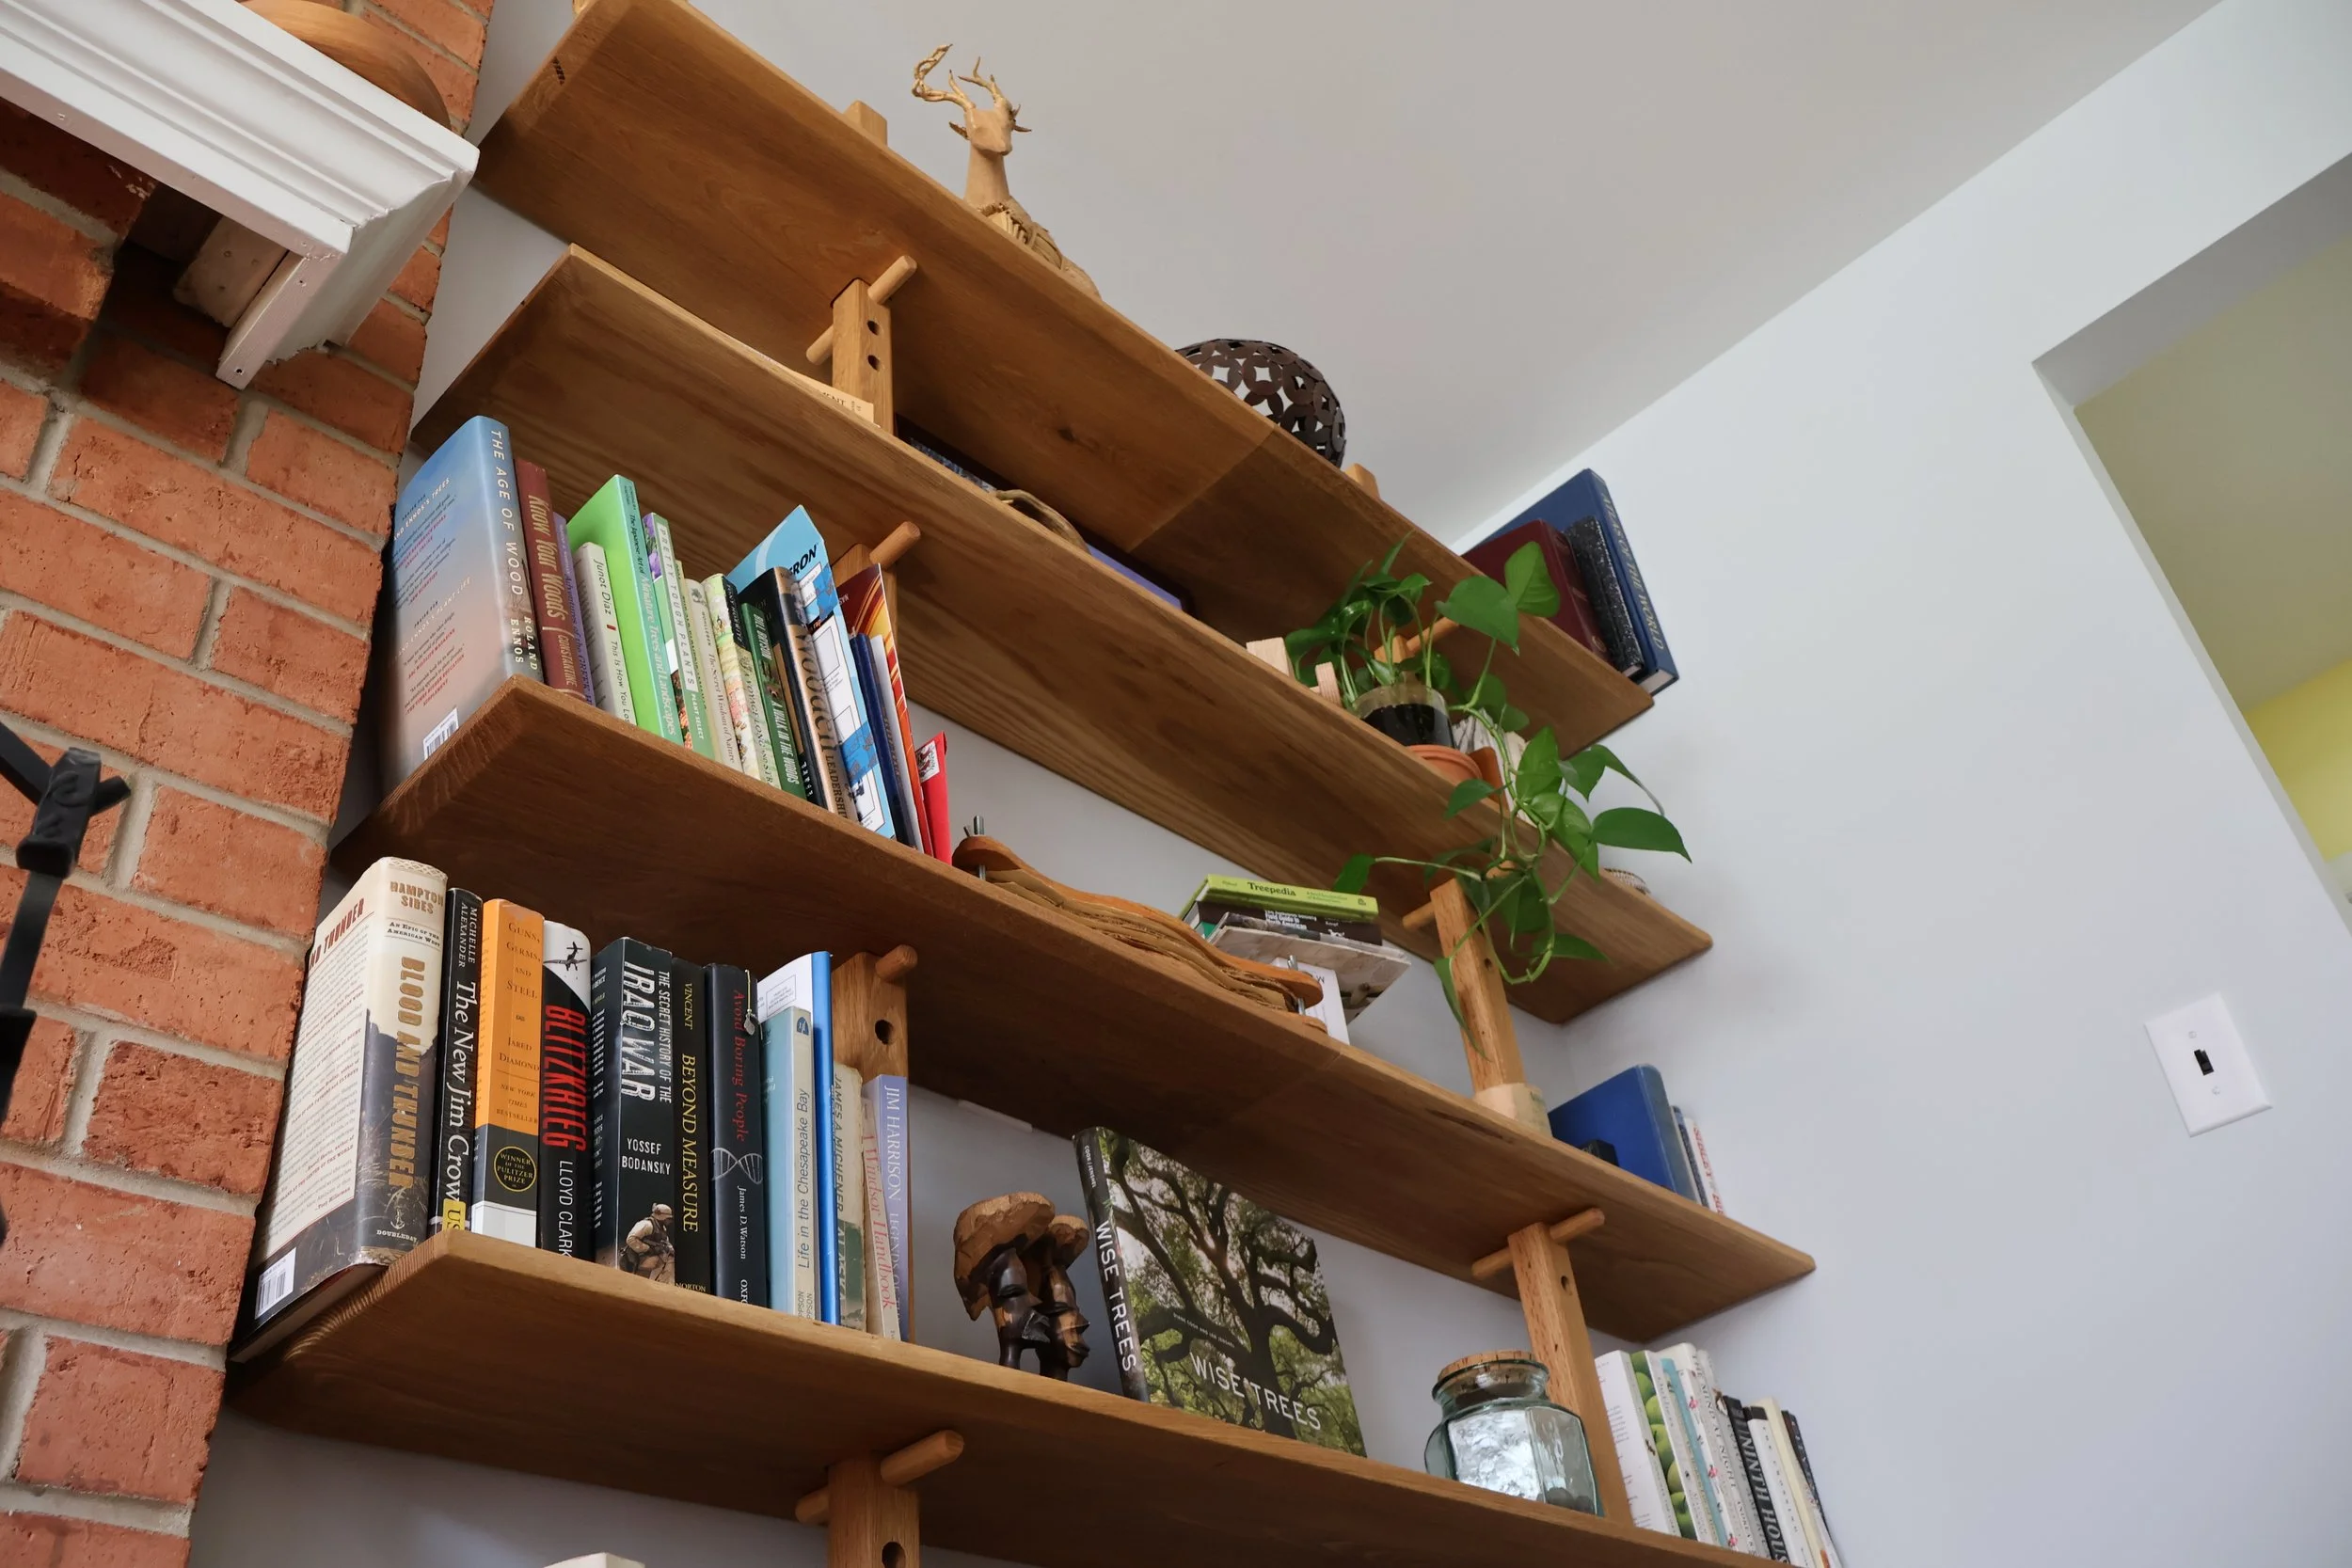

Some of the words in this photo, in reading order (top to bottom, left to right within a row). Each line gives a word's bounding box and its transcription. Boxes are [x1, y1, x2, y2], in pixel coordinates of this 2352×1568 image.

[491, 430, 505, 461] THE
[432, 477, 451, 499] TREES
[496, 467, 511, 500] AGE
[501, 508, 515, 531] OF
[528, 495, 551, 537] Know
[536, 539, 558, 572] Your
[630, 526, 641, 554] Japanese
[506, 542, 523, 595] WOOD
[593, 559, 608, 590] Junot
[541, 573, 569, 621] Woods
[564, 575, 580, 624] Adventures
[641, 574, 657, 624] Miniature
[660, 528, 674, 577] PRETTY
[670, 584, 684, 627] TOUGH
[678, 631, 694, 685] PLANTS
[1619, 539, 1632, 557] OF
[1628, 562, 1644, 591] THE
[1637, 594, 1664, 651] WORLD
[753, 613, 766, 631] BILL
[510, 618, 524, 663] ENNOS
[523, 616, 538, 671] ROLAND
[611, 641, 619, 657] This
[649, 626, 660, 654] Trees
[756, 630, 772, 660] BRYSON
[557, 634, 578, 688] CONSTANTINE
[613, 658, 620, 667] Is
[655, 652, 667, 673] and
[707, 653, 716, 667] The
[711, 667, 722, 693] Secret
[659, 673, 675, 736] Landscapes
[691, 692, 700, 713] PLANT
[717, 693, 728, 723] Wisdom
[747, 679, 758, 716] VOYAGE
[754, 718, 765, 748] LONG
[695, 713, 705, 739] SELECT
[723, 723, 731, 736] of
[773, 707, 787, 730] WALK
[725, 736, 735, 764] Nature
[777, 729, 789, 741] IN
[780, 739, 794, 757] THE
[784, 757, 800, 784] WOODS
[389, 881, 444, 907] HAMPTON
[1247, 881, 1296, 896] Treepedia
[400, 895, 435, 915] SIDES
[323, 897, 365, 954] THUNDER
[457, 902, 469, 968] ALEXANDER
[468, 906, 478, 964] MICHELLE
[508, 922, 540, 942] GUNS,
[506, 941, 541, 962] GERMS,
[515, 966, 532, 978] AND
[658, 971, 671, 989] THE
[397, 956, 426, 1027] BLOOD
[455, 980, 478, 1023] The
[506, 980, 538, 999] STEEL
[620, 960, 656, 1032] IRAQ
[659, 989, 671, 1026] SECRET
[684, 982, 694, 1031] VINCENT
[733, 989, 746, 1032] Avoid
[394, 1030, 421, 1078] AND
[452, 1029, 474, 1080] New
[507, 1037, 532, 1051] JARED
[659, 1026, 672, 1069] HISTORY
[499, 1052, 540, 1071] DIAMOND
[620, 1037, 656, 1101] WAR
[659, 1069, 672, 1083] OF
[731, 1037, 746, 1087] Boring
[500, 1083, 516, 1092] NEW
[517, 1087, 536, 1099] YORK
[542, 1005, 587, 1152] BLITZKRIEG
[681, 1053, 697, 1134] BEYOND
[446, 1081, 472, 1128] Jim
[508, 1098, 528, 1109] TIMES
[659, 1085, 673, 1104] THE
[796, 1087, 810, 1113] Bay
[834, 1073, 843, 1119] JAMES
[883, 1085, 900, 1111] JIM
[496, 1108, 538, 1124] BESTSELLER
[732, 1092, 749, 1142] People
[388, 1083, 419, 1190] THUNDER
[627, 1137, 662, 1156] YOSSEF
[444, 1134, 469, 1203] Crow
[500, 1152, 532, 1166] WINNER
[621, 1155, 671, 1176] BODANSKY
[797, 1115, 811, 1196] Chesapeake
[886, 1116, 901, 1202] HARRISON
[497, 1165, 533, 1180] PULITZER
[503, 1173, 526, 1185] PRIZE
[559, 1160, 574, 1206] LLOYD
[681, 1138, 699, 1233] MEASURE
[834, 1133, 844, 1212] MICHENER
[866, 1148, 883, 1216] Windsor
[1089, 1164, 1097, 1189] JENSHEL
[737, 1185, 747, 1213] James
[798, 1199, 809, 1224] the
[376, 1228, 418, 1243] DOUBLEDAY
[558, 1211, 574, 1258] CLARK
[739, 1216, 748, 1227] D.
[798, 1227, 809, 1243] in
[739, 1227, 749, 1260] Watson
[889, 1212, 900, 1265] LEGENDS
[798, 1244, 810, 1270] Life
[873, 1220, 897, 1309] Handbook
[675, 1281, 707, 1292] NORTON
[1096, 1221, 1120, 1282] WISE
[1109, 1286, 1137, 1372] TREES
[1189, 1352, 1245, 1399] WISE
[1250, 1381, 1321, 1431] TREES
[1701, 1384, 1716, 1419] MIND
[1713, 1426, 1721, 1438] AT
[1719, 1444, 1737, 1488] NIGHT
[1740, 1437, 1767, 1502] NINTH
